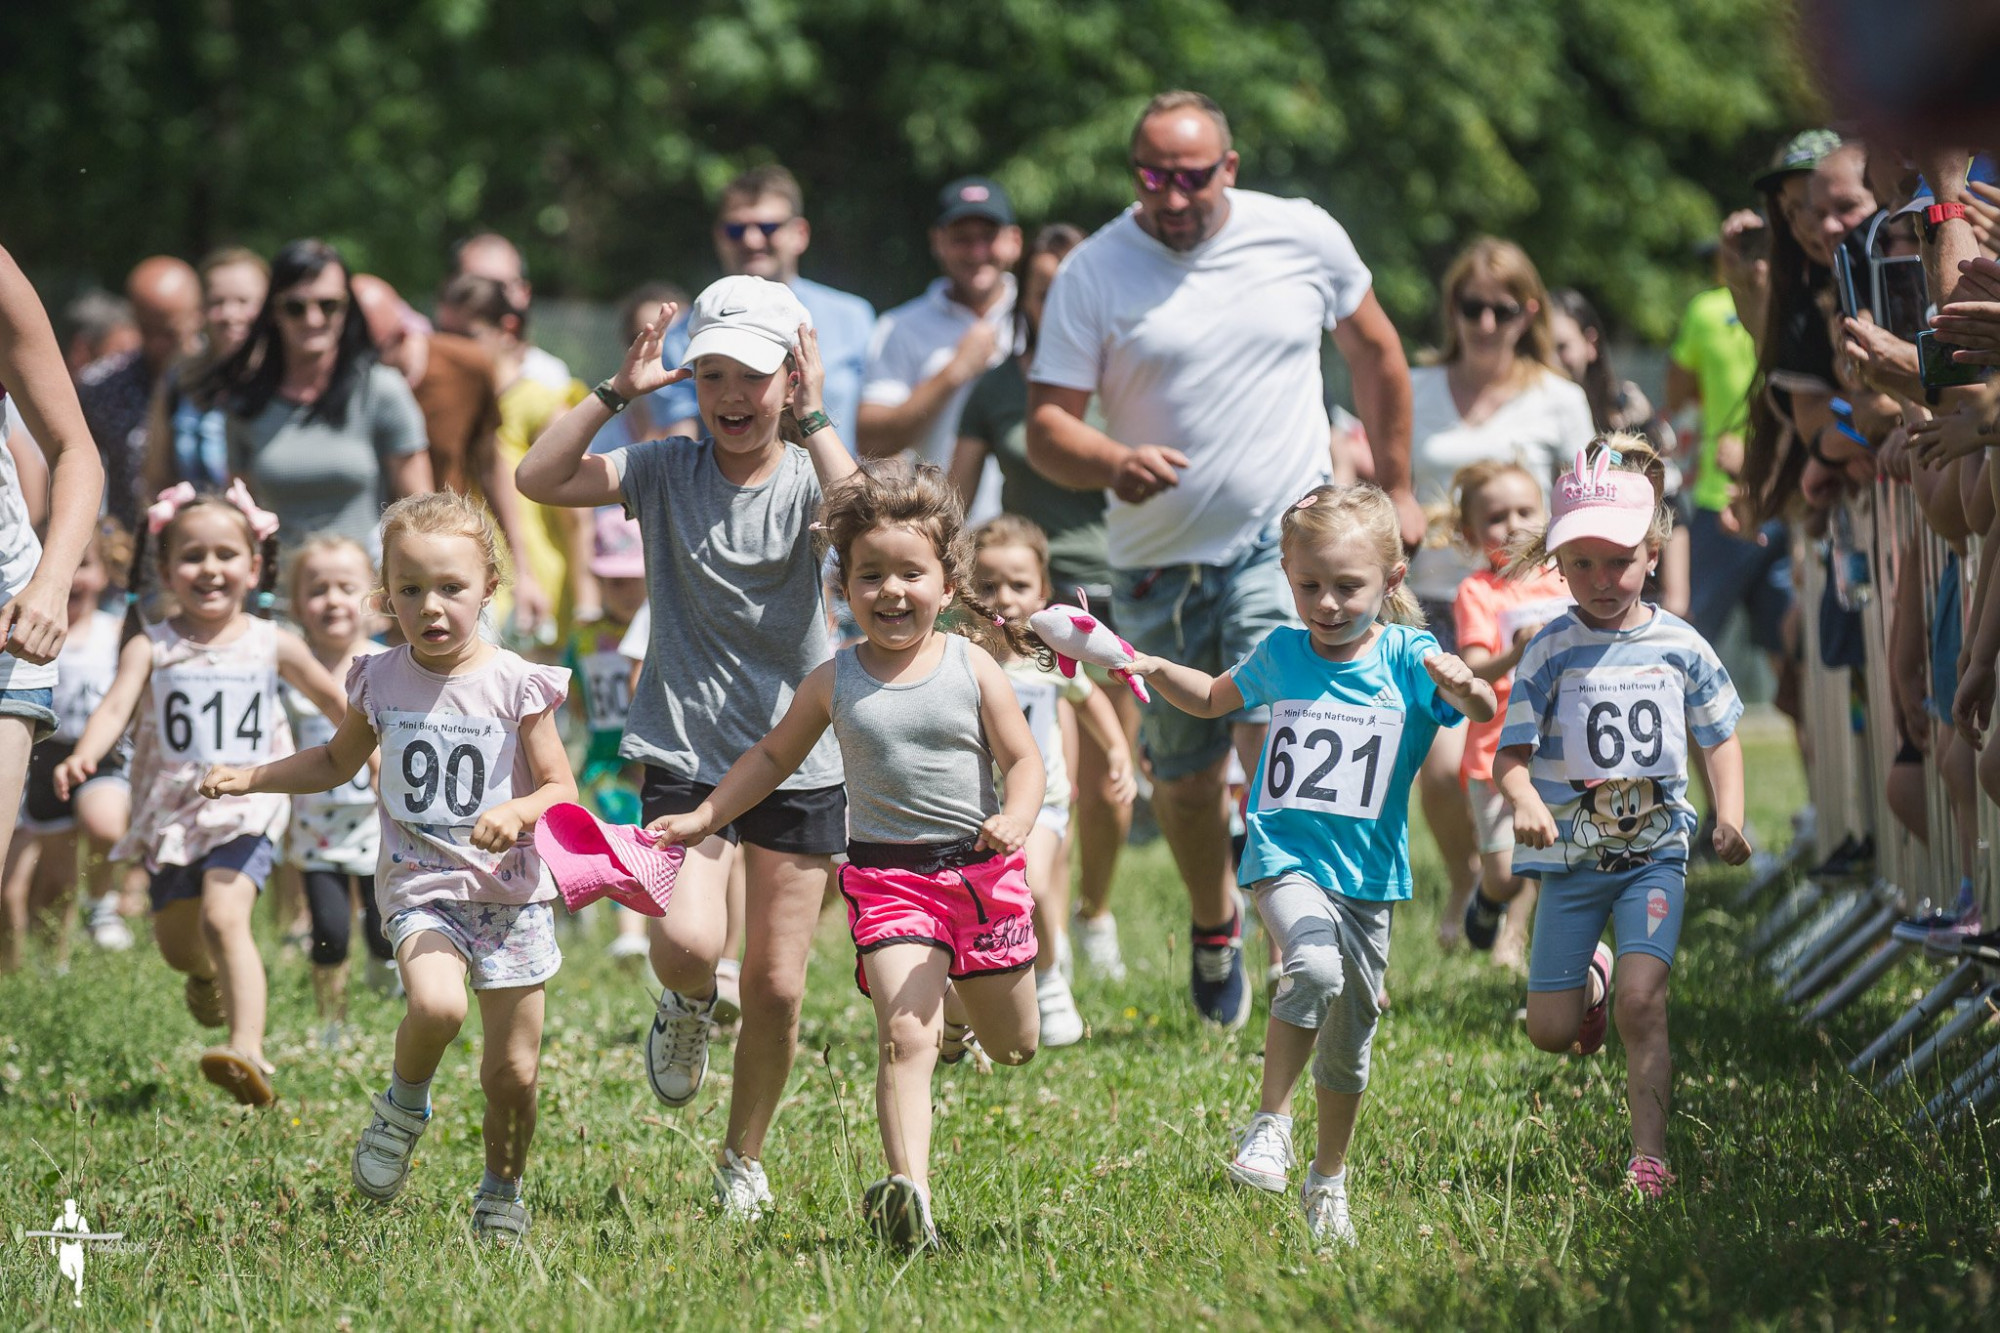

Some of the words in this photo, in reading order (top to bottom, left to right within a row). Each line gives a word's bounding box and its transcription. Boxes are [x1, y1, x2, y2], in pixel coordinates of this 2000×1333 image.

[1284, 709, 1301, 718] Mini
[1302, 710, 1321, 721] Bieg
[1324, 711, 1365, 725] Naftowy
[1579, 684, 1597, 693] Mini
[1600, 684, 1617, 692] Bieg
[1619, 683, 1656, 691] Naftowy
[164, 691, 263, 752] 614
[399, 721, 417, 730] Mini
[419, 722, 438, 733] Bieg
[441, 723, 480, 736] Naftowy
[1586, 699, 1663, 769] 69
[402, 739, 485, 817] 90
[1268, 726, 1382, 808] 621
